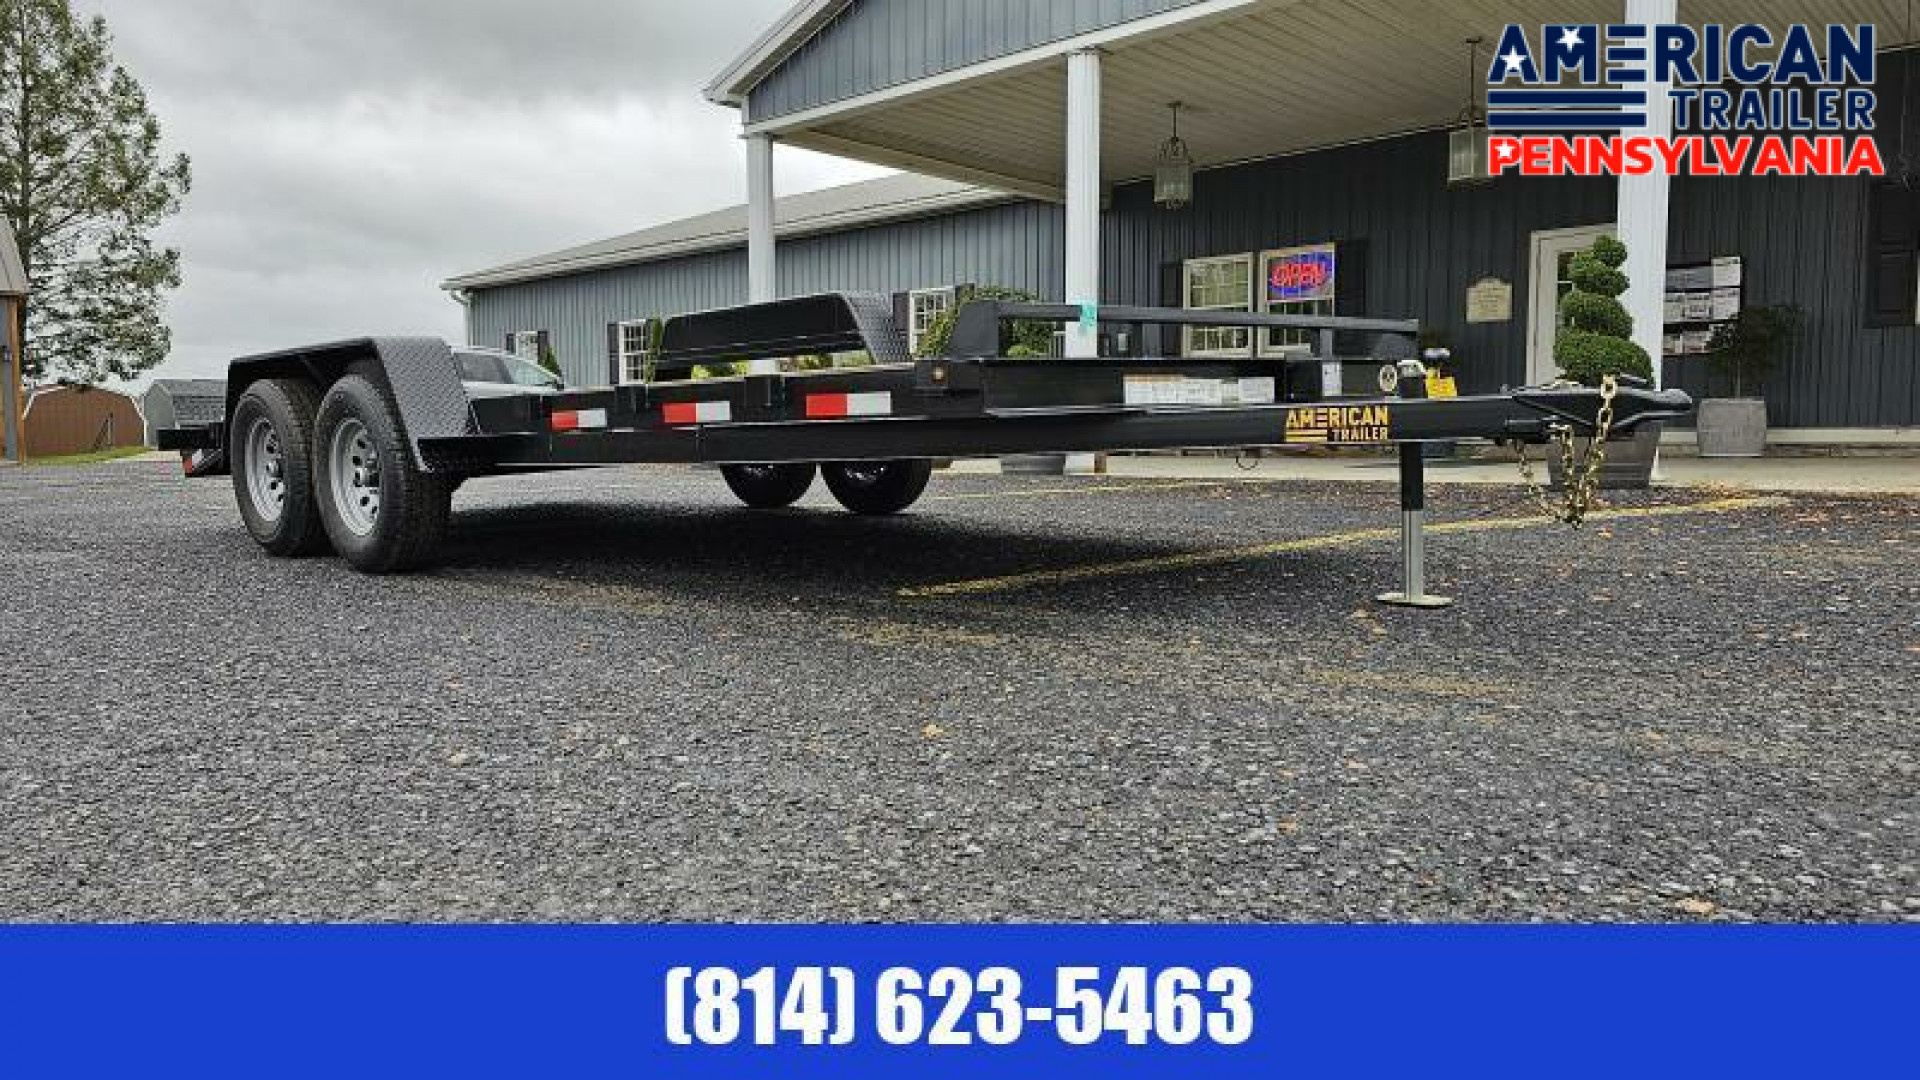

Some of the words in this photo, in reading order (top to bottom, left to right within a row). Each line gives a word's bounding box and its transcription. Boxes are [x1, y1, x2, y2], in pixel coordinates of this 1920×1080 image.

[1271, 262, 1328, 288] OPEN
[1286, 405, 1388, 428] AMERICAN
[1331, 426, 1388, 441] TRAILER
